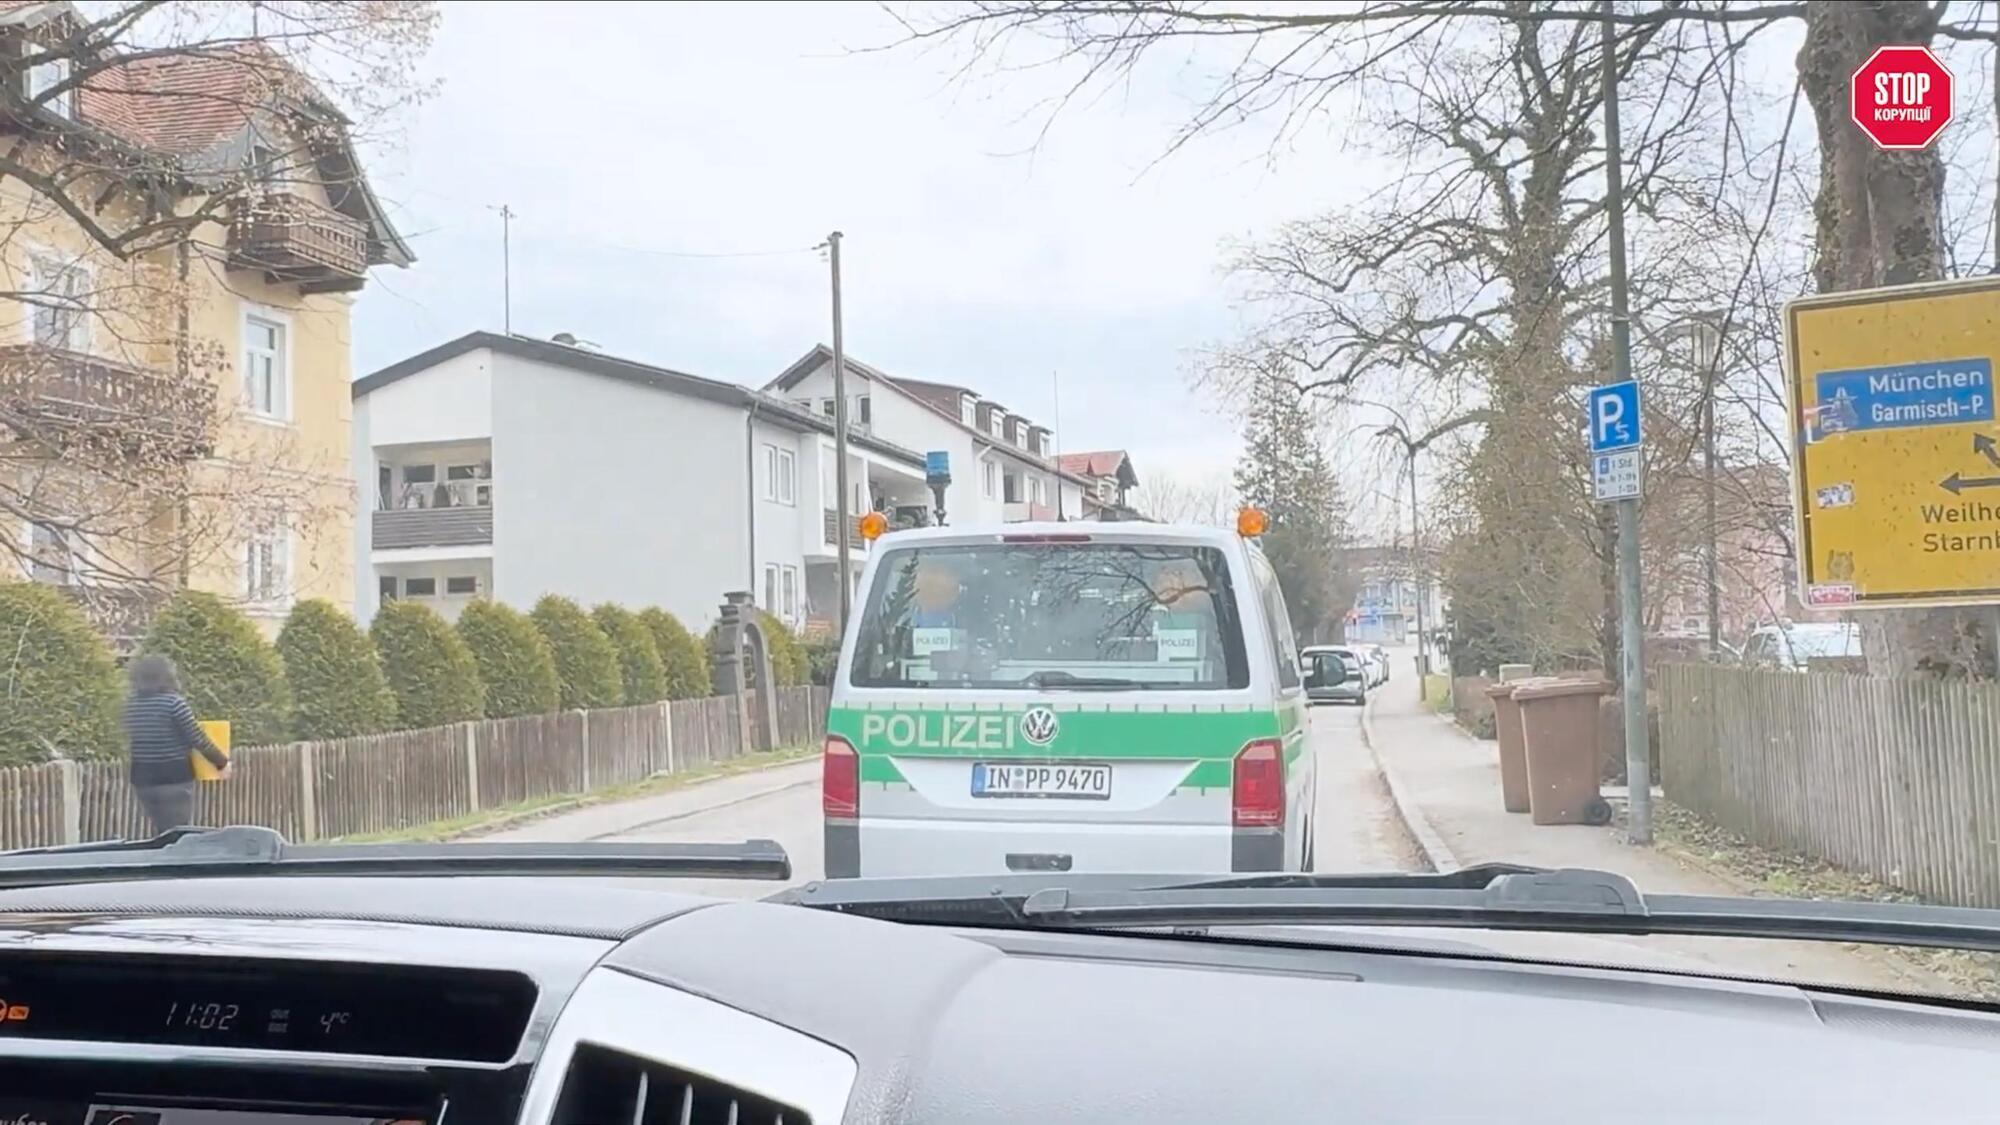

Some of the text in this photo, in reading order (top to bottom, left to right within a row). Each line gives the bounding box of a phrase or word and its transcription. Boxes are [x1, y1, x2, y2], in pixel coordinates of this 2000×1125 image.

[1869, 370, 1984, 394] München
[1598, 394, 1624, 441] P
[1872, 395, 1984, 422] Garmisch-P
[916, 635, 949, 645] POLIZEI
[1160, 638, 1195, 647] POLIZEI
[862, 714, 1014, 748] POLIZEI
[988, 768, 1105, 790] IN PP 9470
[166, 1002, 239, 1030] 11:02
